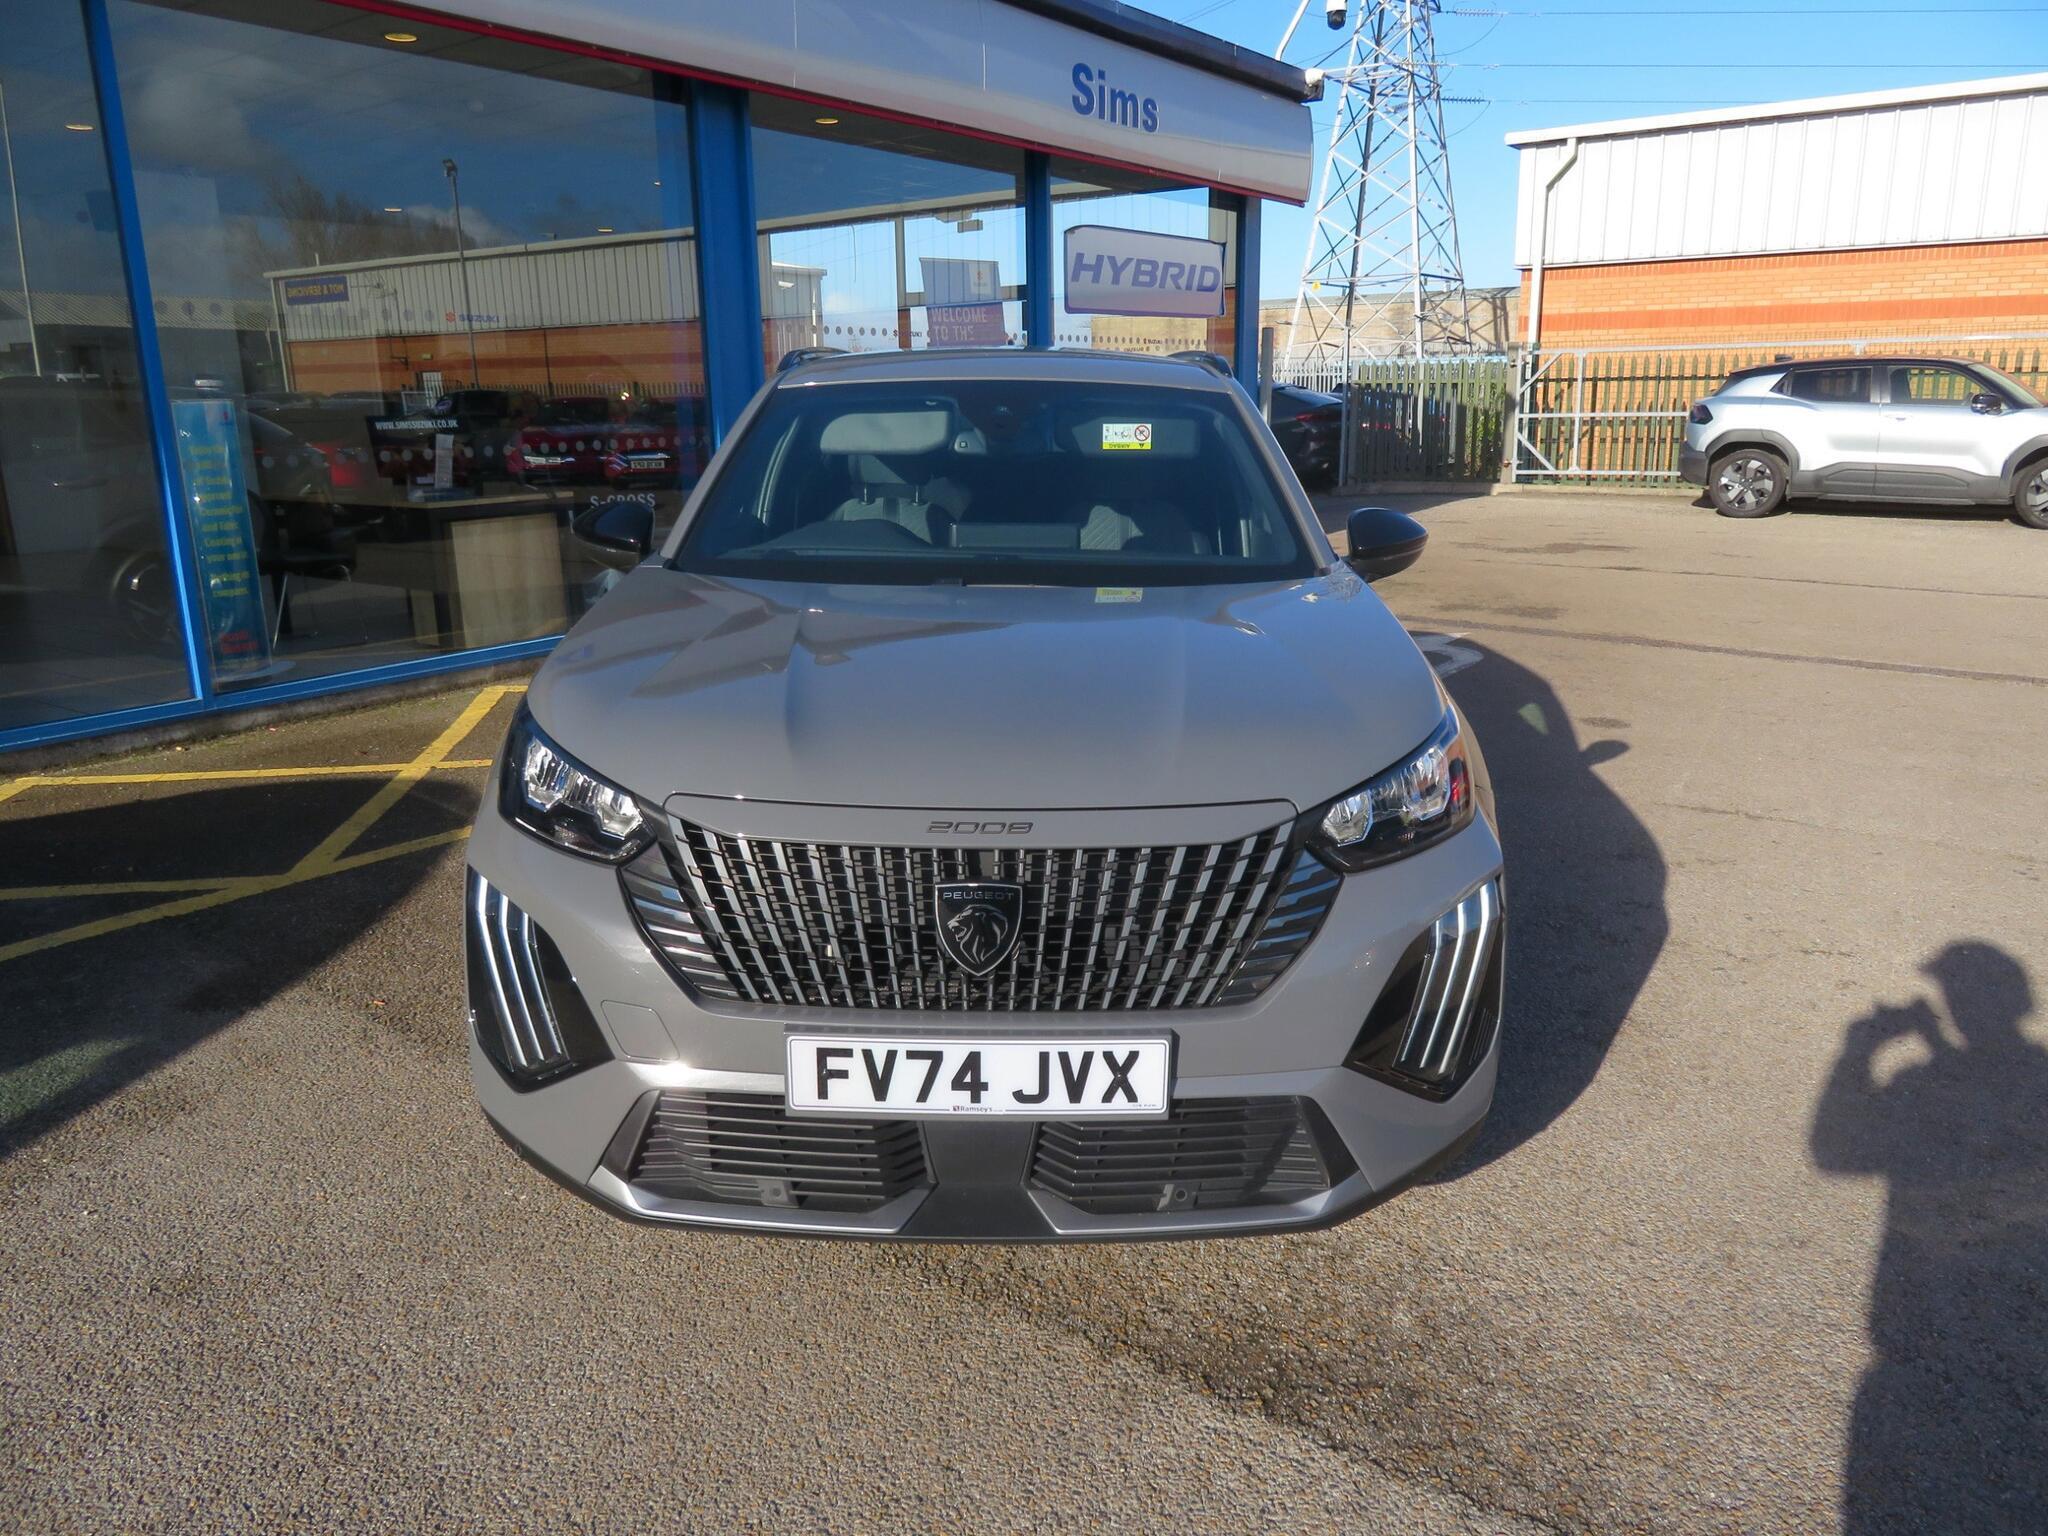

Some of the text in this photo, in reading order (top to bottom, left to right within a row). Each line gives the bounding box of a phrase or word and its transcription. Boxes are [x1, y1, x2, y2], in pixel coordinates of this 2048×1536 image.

[1072, 62, 1159, 133] Sims
[1071, 252, 1221, 293] HYBRID
[931, 307, 988, 323] WELCOME
[933, 325, 949, 341] TO
[927, 821, 1034, 835] 2008
[942, 891, 1014, 901] PEUGEOT
[816, 1047, 1140, 1104] FV74 JVX
